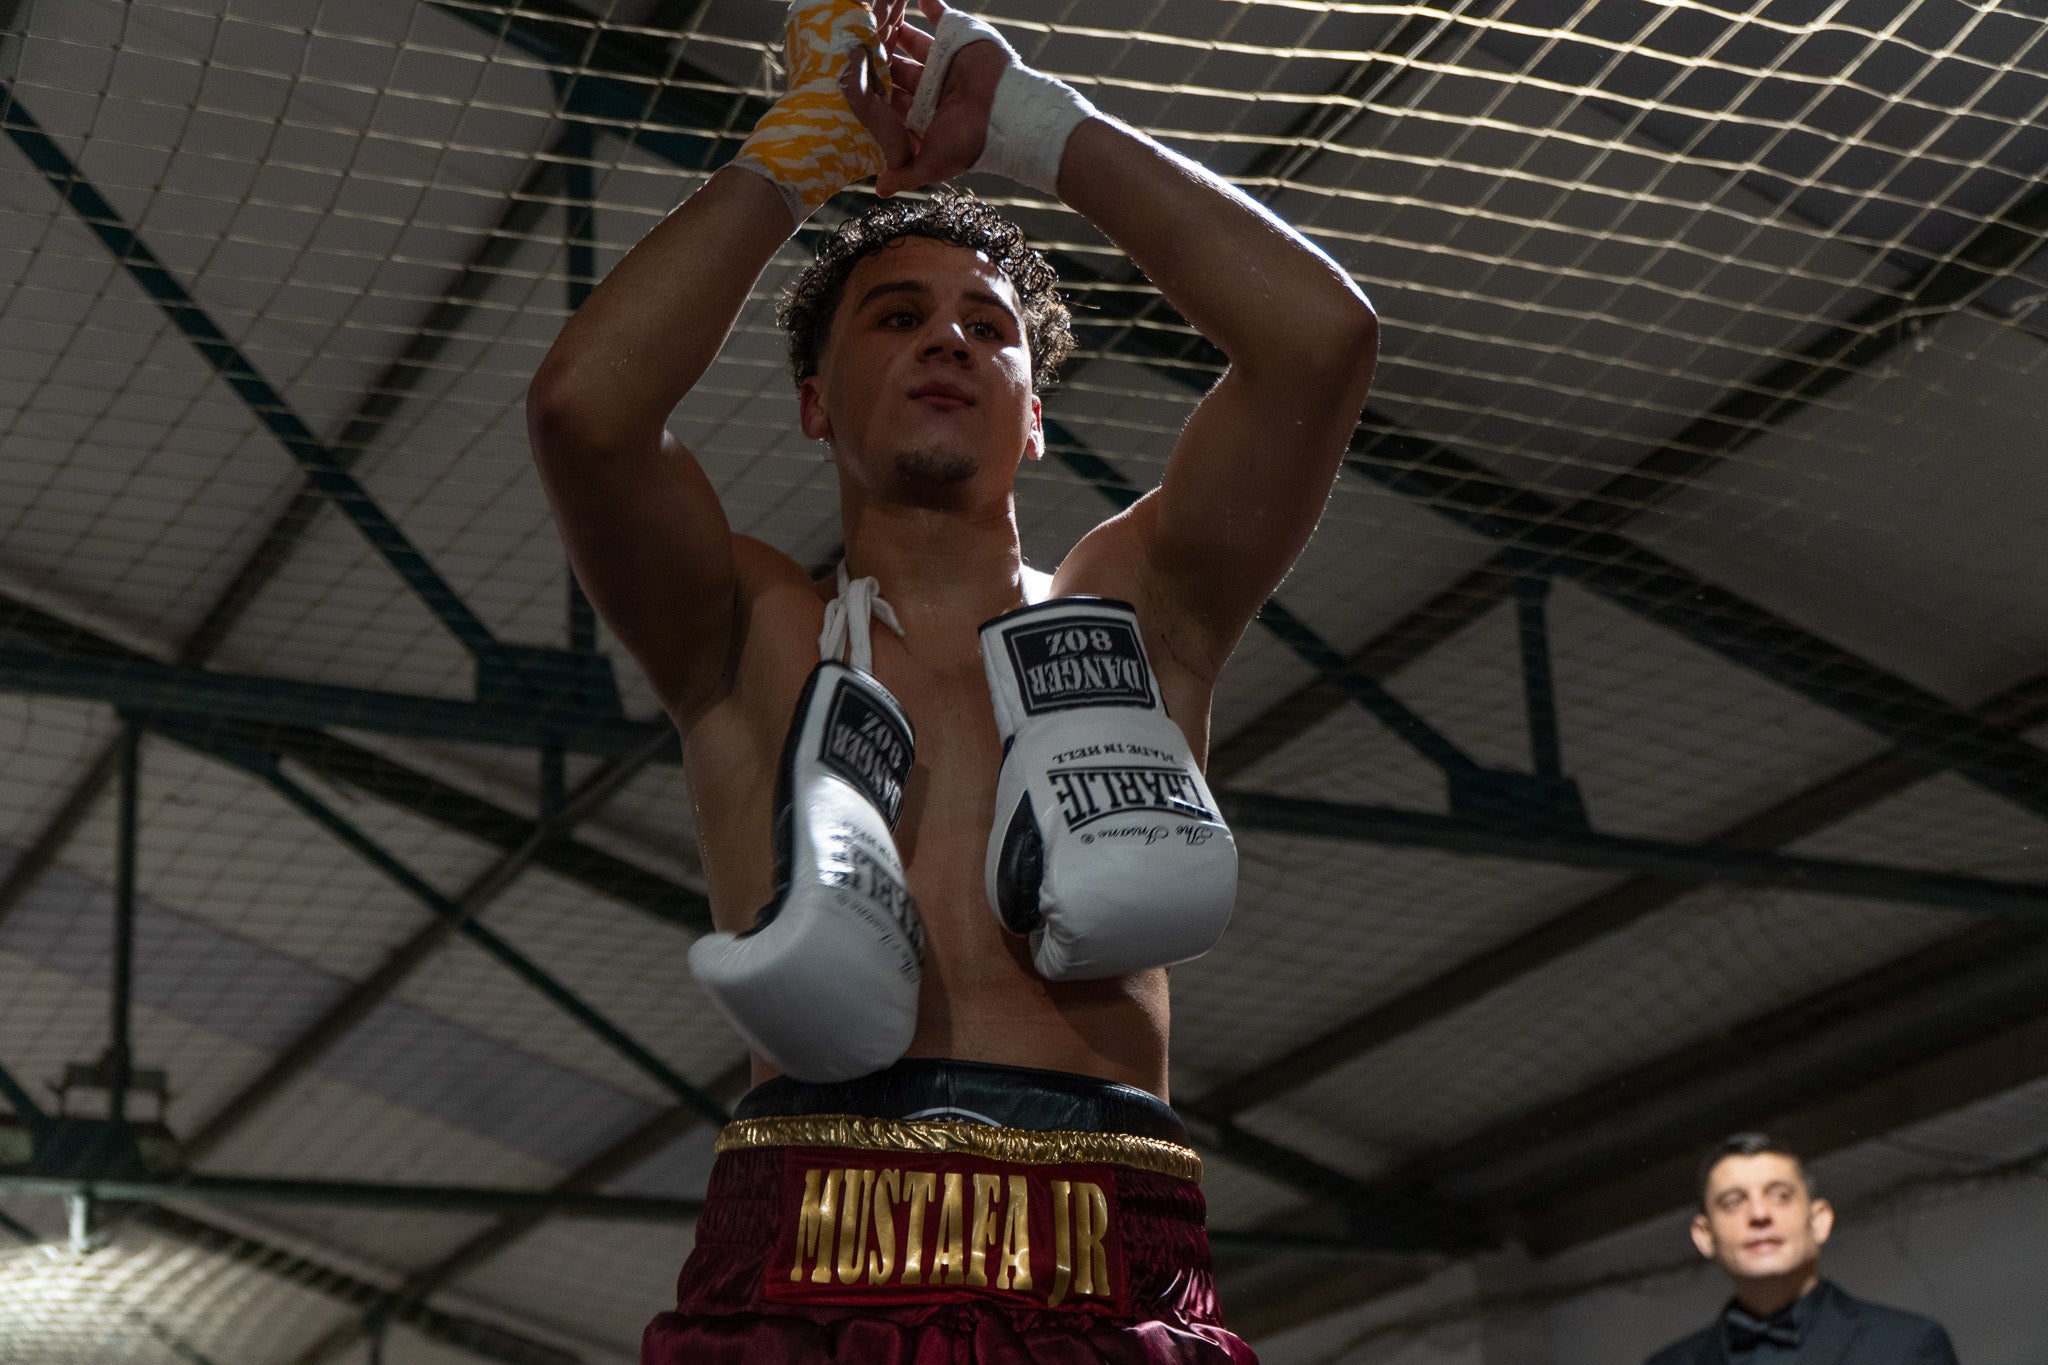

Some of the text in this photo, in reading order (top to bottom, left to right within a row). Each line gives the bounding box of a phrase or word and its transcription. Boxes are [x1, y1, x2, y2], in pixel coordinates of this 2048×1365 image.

[1026, 654, 1144, 697] DANGER
[1052, 743, 1177, 765] MADE IN HELL
[1047, 771, 1213, 827] CHARLIE
[1175, 825, 1213, 847] The
[790, 1167, 1111, 1308] MUSTAFA JR
